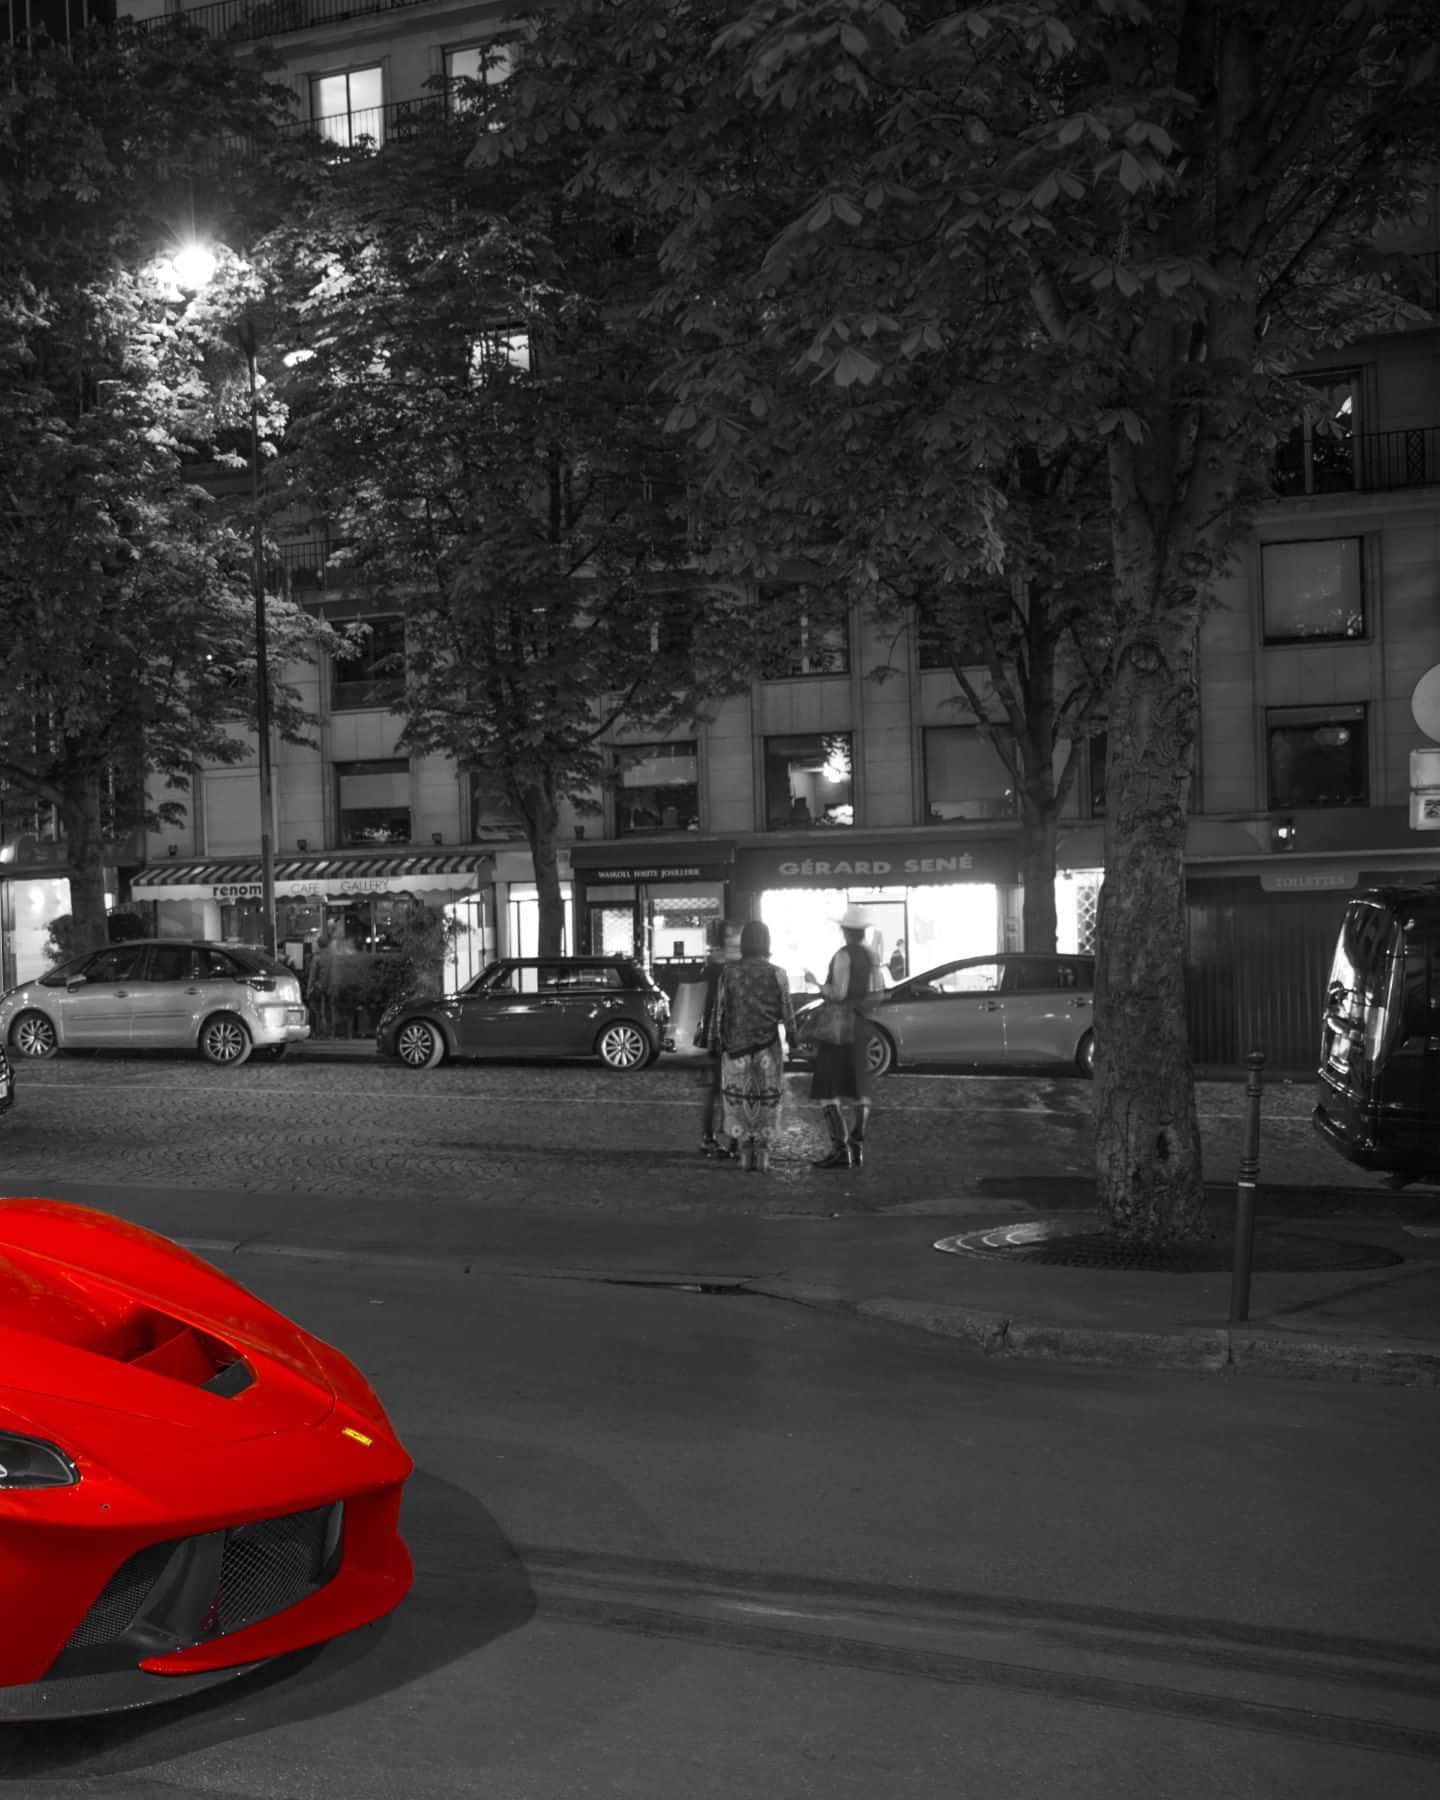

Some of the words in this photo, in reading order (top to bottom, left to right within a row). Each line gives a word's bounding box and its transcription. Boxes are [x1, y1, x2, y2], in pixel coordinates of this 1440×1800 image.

[778, 858, 891, 875] GÉRARD
[903, 852, 973, 873] SENÉ
[340, 879, 389, 894] GALLERY
